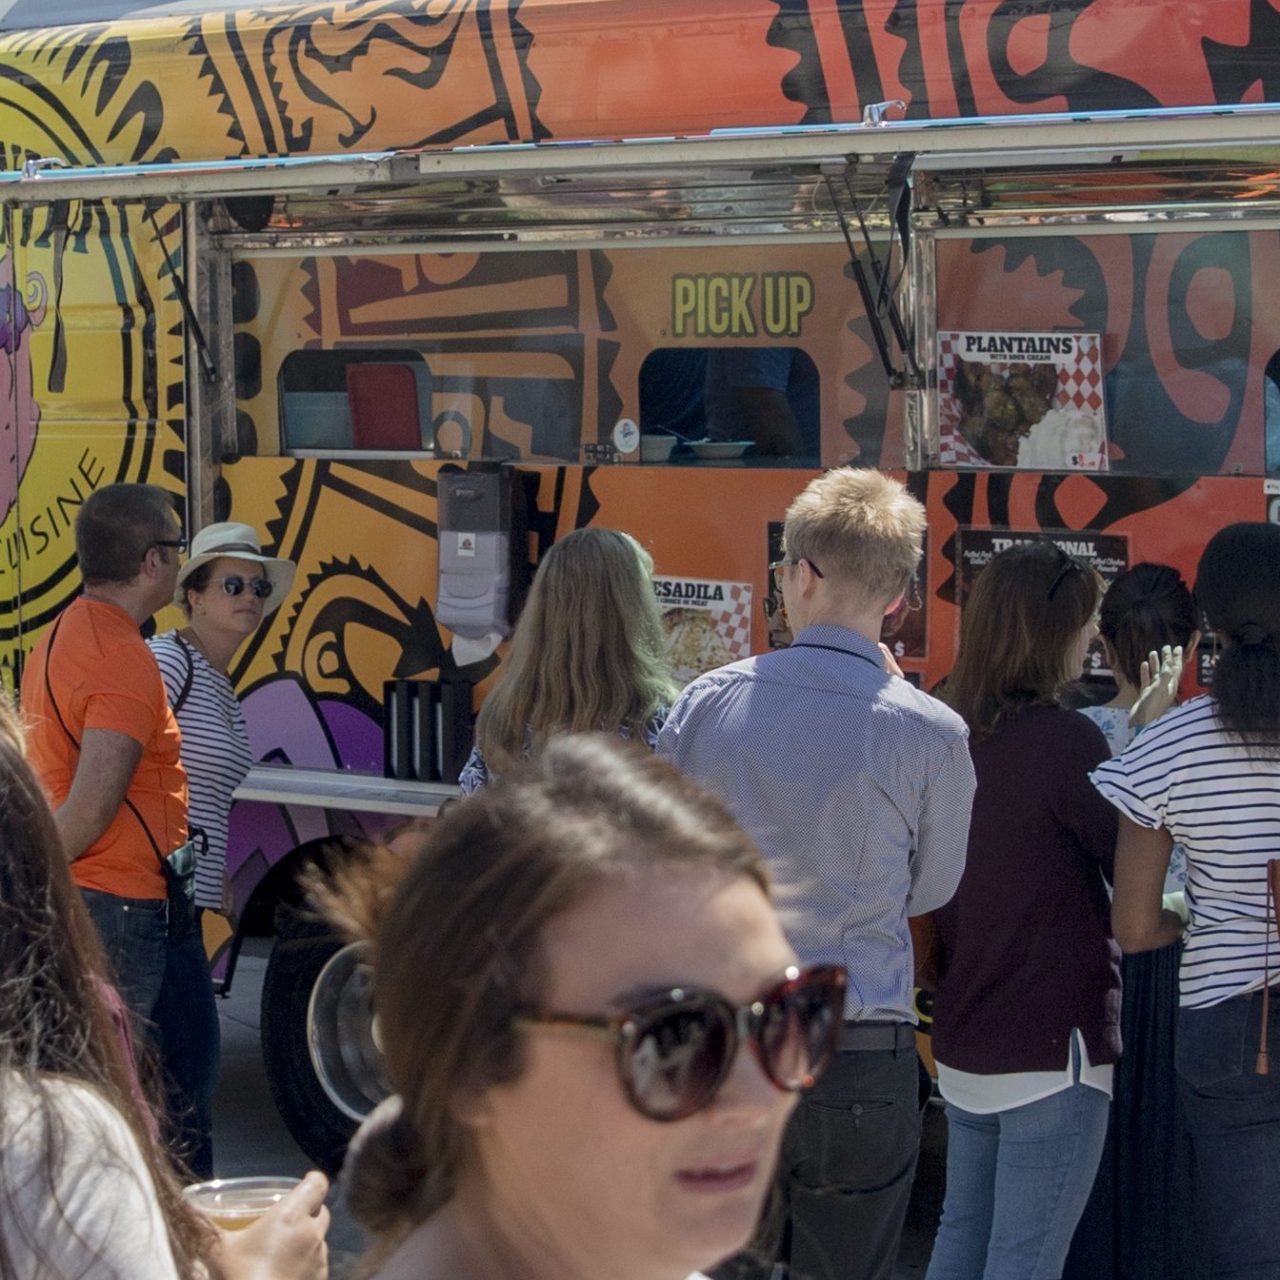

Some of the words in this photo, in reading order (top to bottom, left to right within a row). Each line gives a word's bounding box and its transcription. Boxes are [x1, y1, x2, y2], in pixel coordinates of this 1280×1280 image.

[674, 275, 755, 335] PICK
[763, 275, 812, 335] UP
[965, 335, 1073, 354] PLANTAINS
